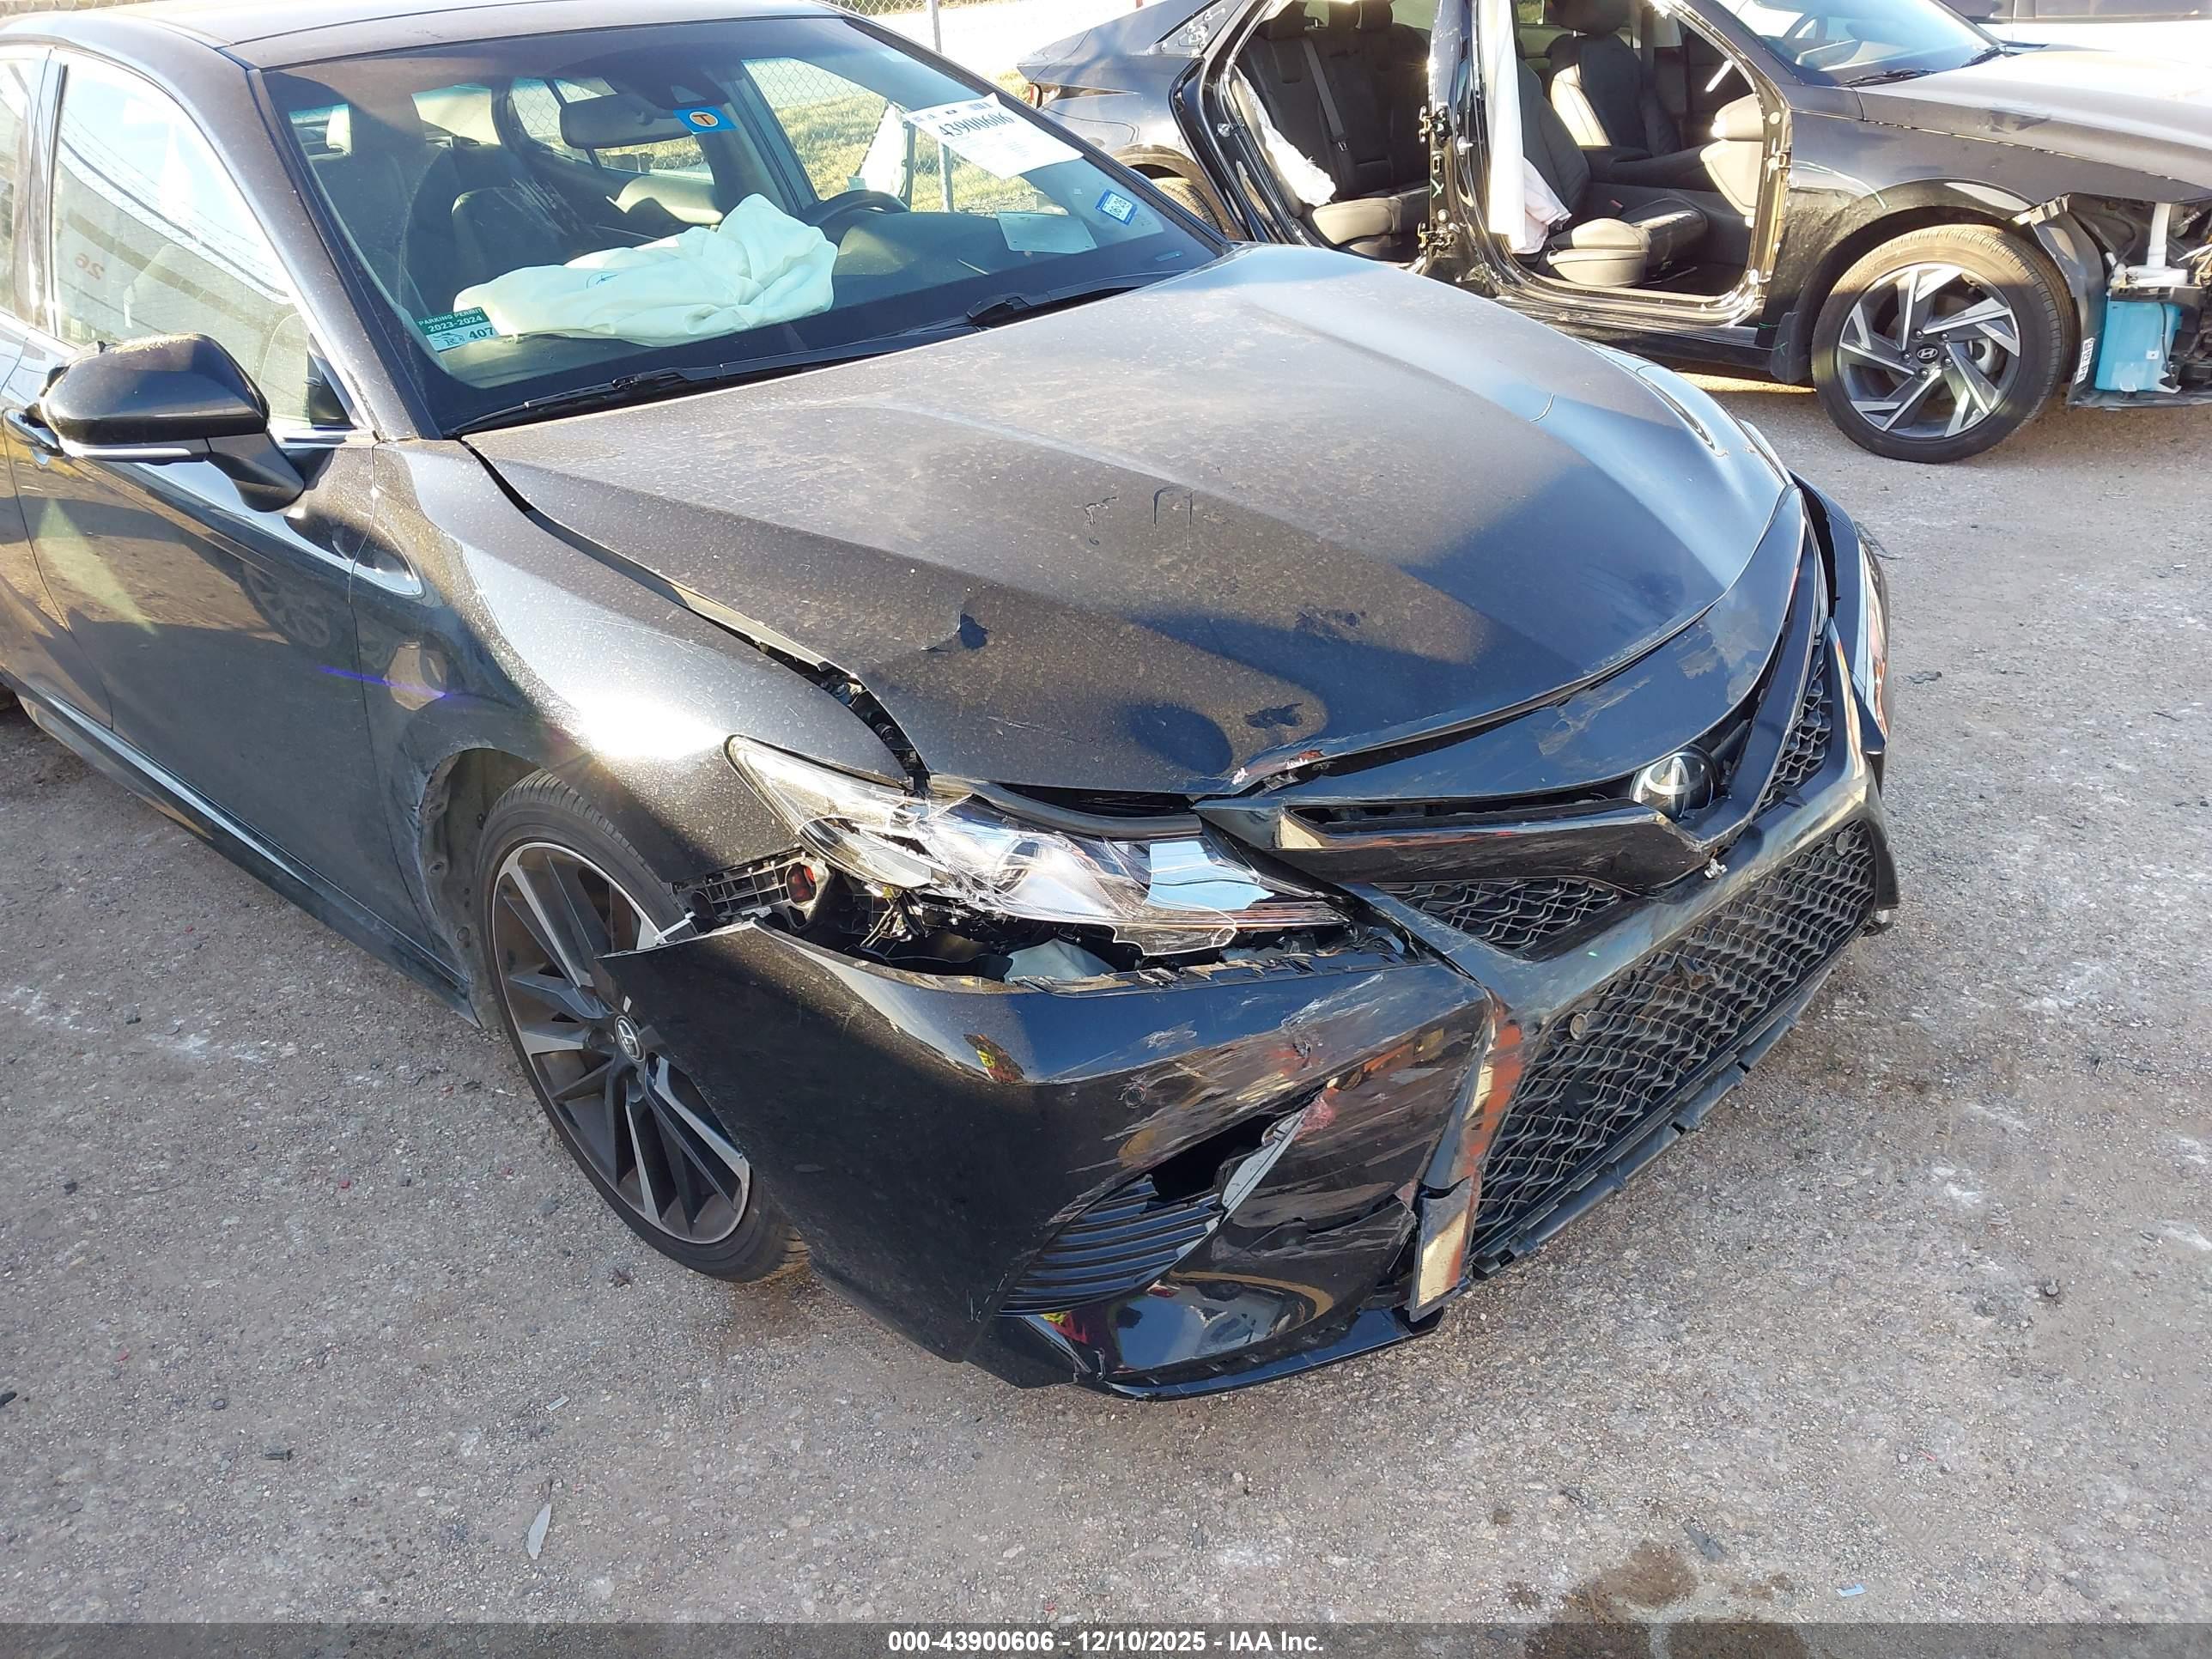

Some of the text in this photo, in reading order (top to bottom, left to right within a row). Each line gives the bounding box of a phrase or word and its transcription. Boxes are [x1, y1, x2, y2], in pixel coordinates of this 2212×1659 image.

[938, 112, 1015, 137] 43900606
[418, 308, 483, 326] PARKING PERMIT
[428, 315, 483, 332] 2023-2024
[469, 327, 495, 340] 407
